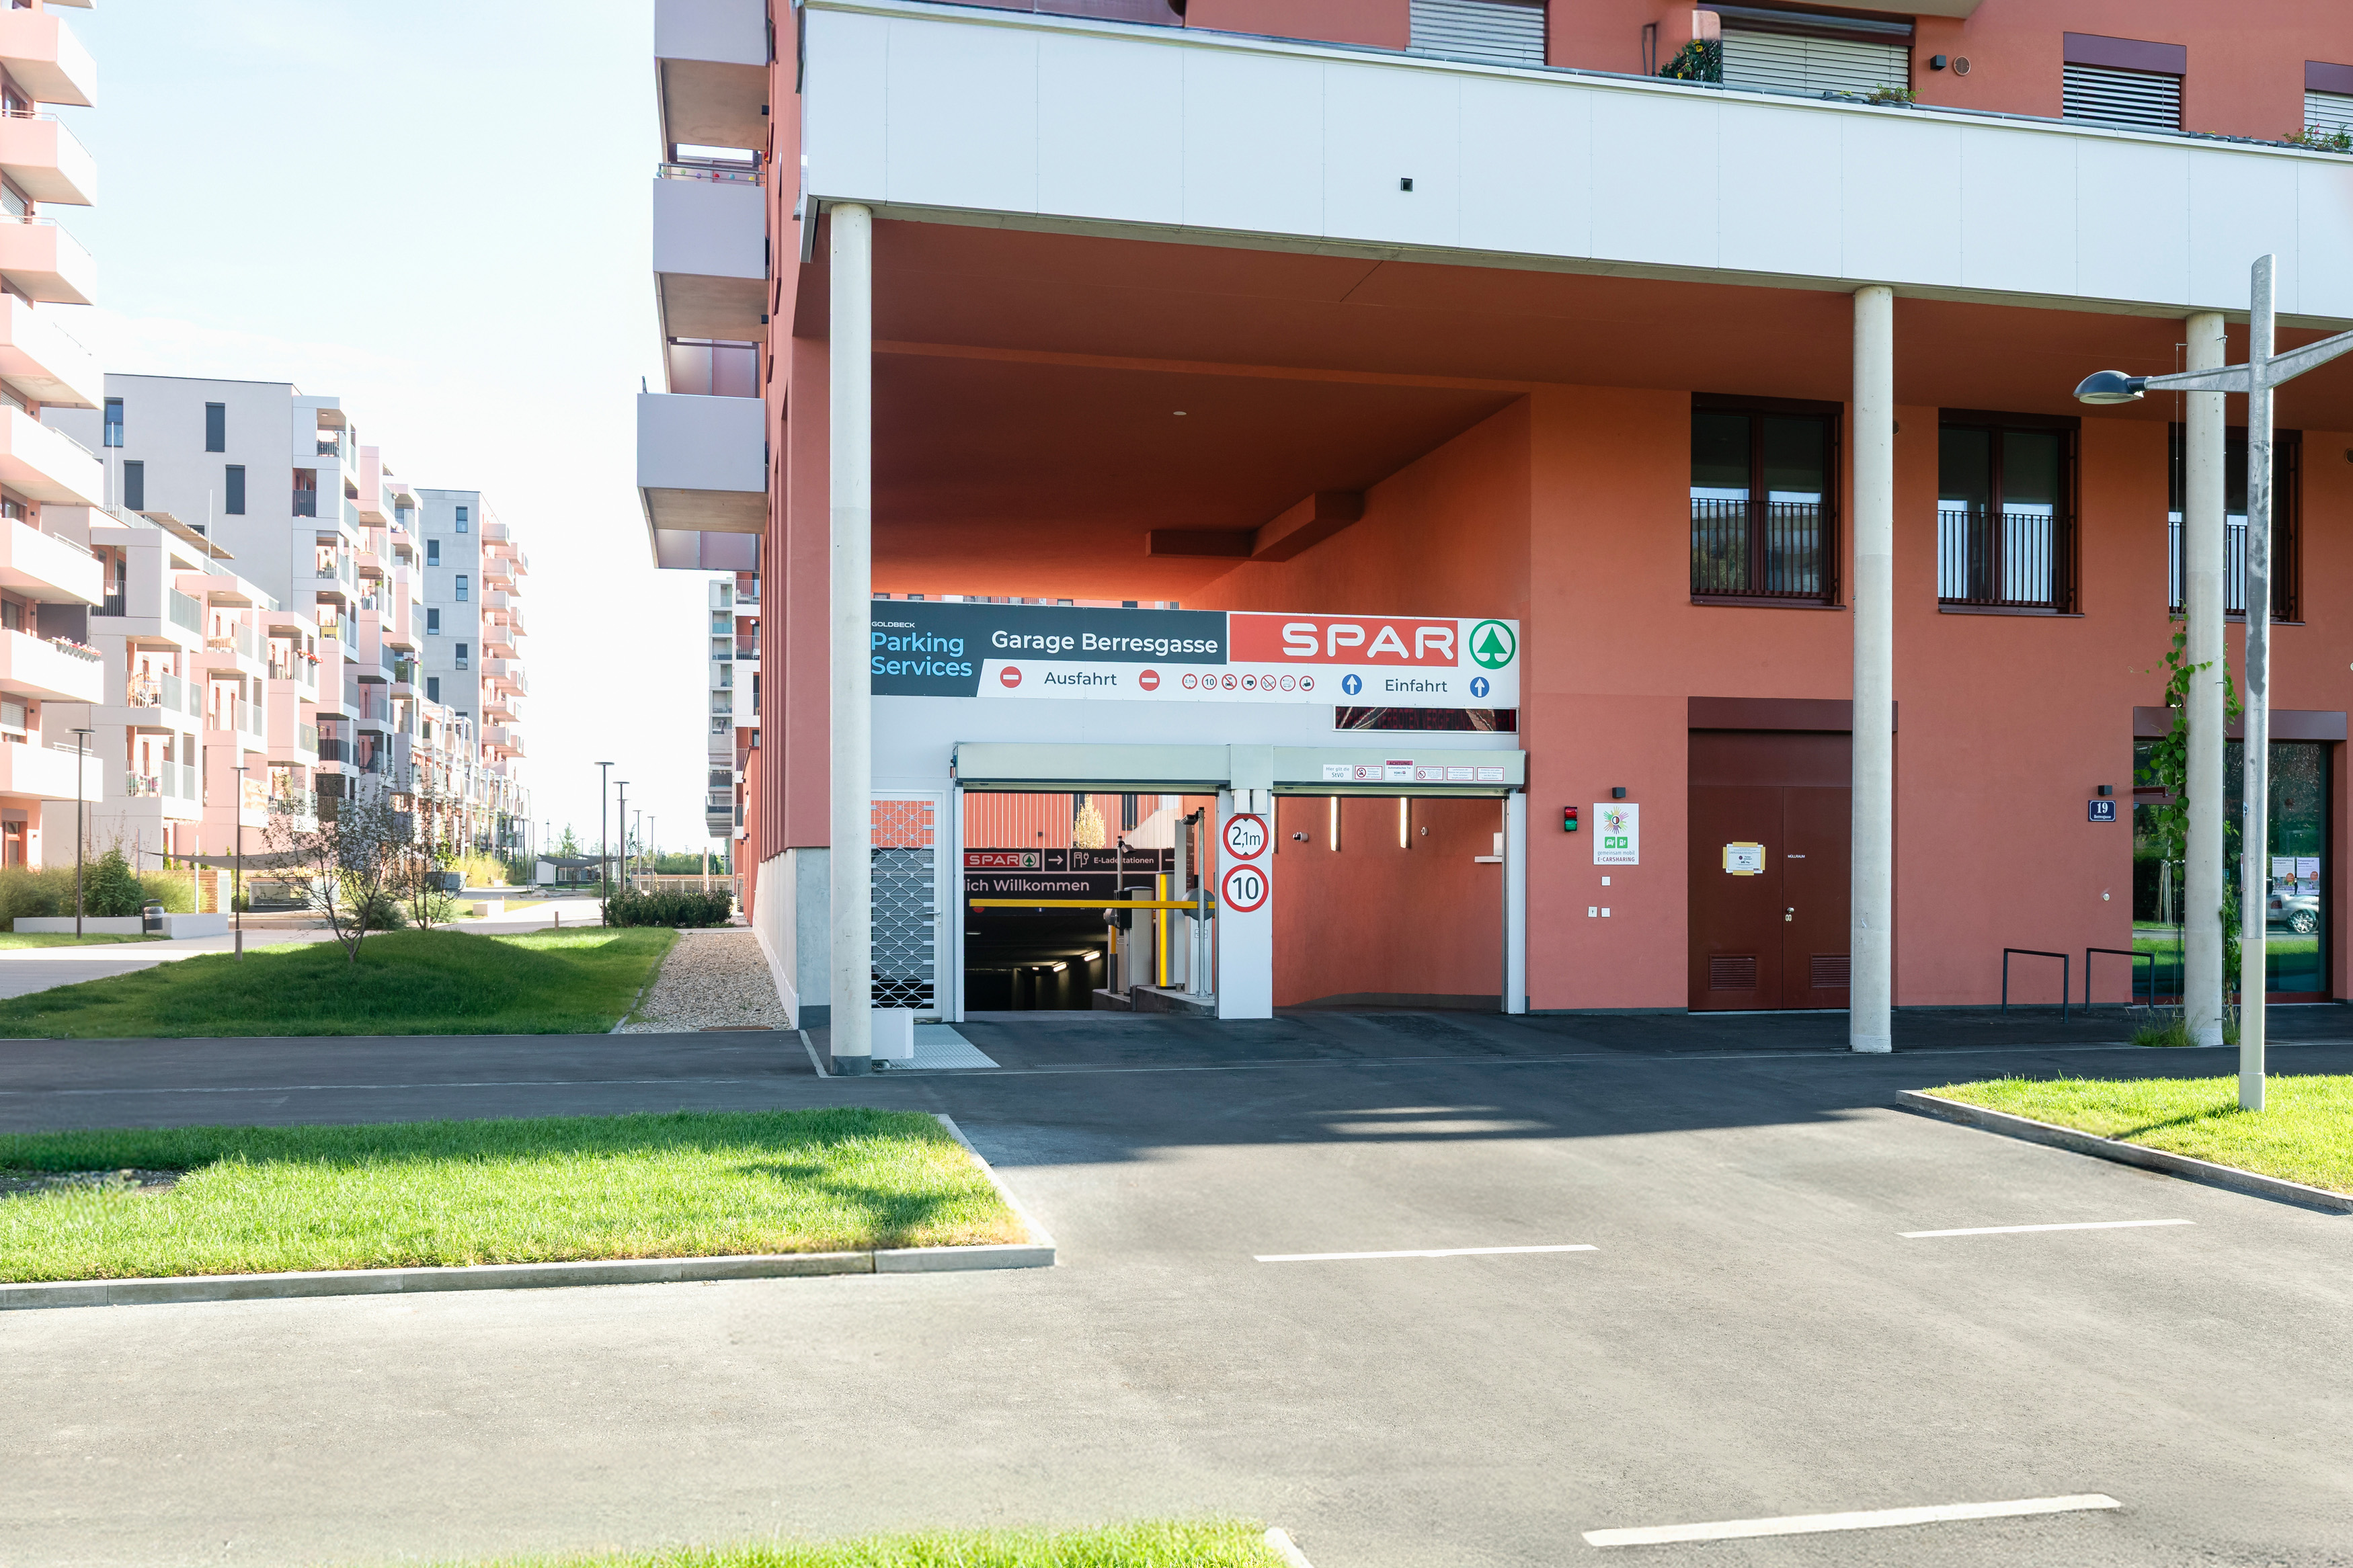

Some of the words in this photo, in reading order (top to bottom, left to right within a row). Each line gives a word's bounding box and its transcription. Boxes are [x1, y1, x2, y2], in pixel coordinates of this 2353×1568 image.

[871, 632, 964, 657] Parking
[992, 630, 1074, 654] Garage
[1082, 633, 1218, 656] Berresgasse
[1282, 622, 1454, 659] SPAR
[871, 655, 973, 677] Services
[1044, 672, 1117, 686] Ausfahrt
[1385, 679, 1447, 692] Einfahrt
[2097, 802, 2108, 813] 19
[1232, 826, 1261, 848] 2,1m
[969, 855, 1019, 865] SPAR
[993, 880, 1089, 891] Willkommen
[1232, 876, 1259, 900] 10
